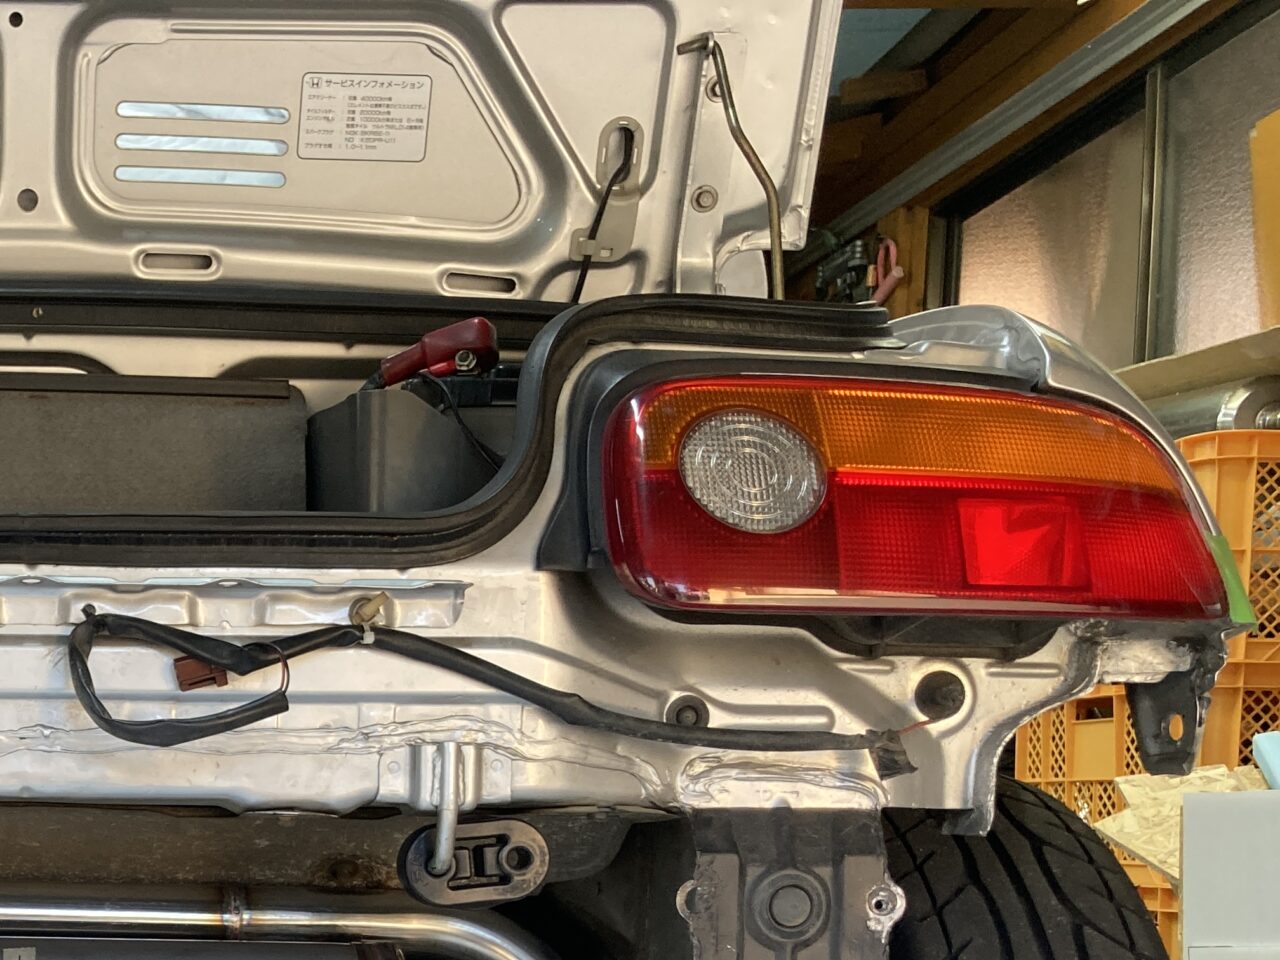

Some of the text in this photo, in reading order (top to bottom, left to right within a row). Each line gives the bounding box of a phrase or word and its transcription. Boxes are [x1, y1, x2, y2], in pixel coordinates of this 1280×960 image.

[325, 79, 424, 89] サービスインフォメーション
